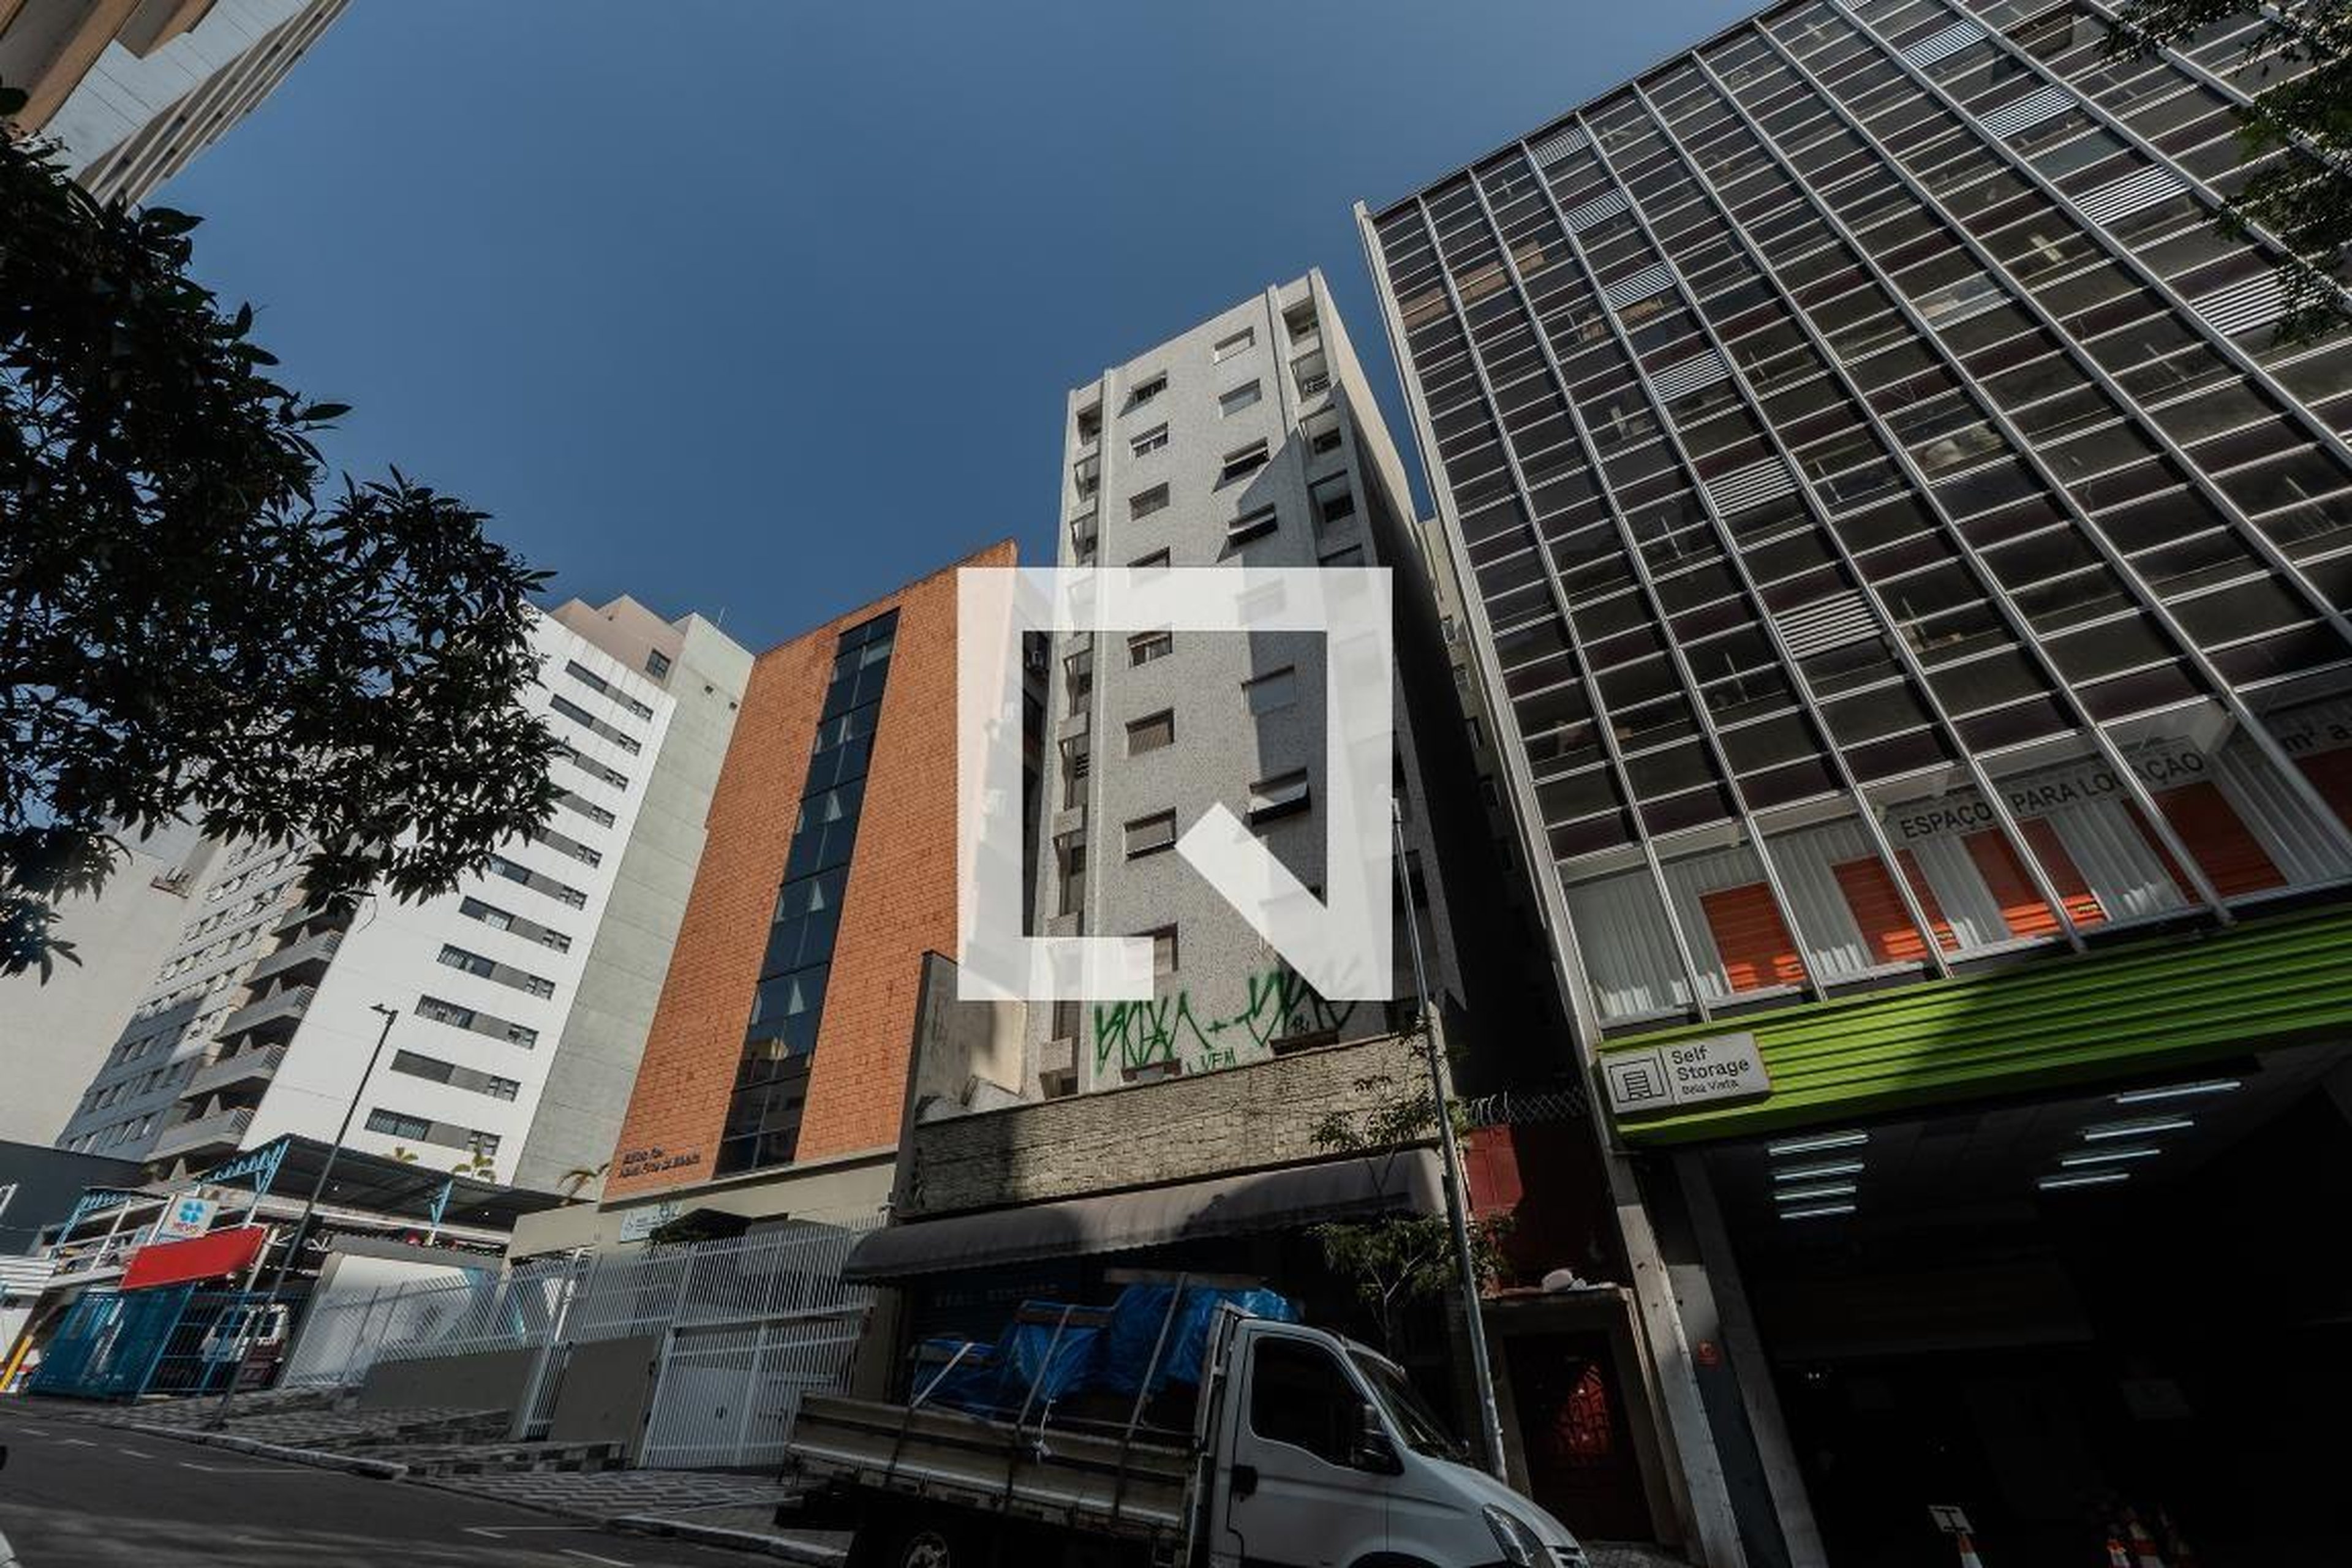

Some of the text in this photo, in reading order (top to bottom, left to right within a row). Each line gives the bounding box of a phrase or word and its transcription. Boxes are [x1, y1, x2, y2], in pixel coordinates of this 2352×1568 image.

[1900, 802, 1992, 839] ESPAÇO
[2010, 783, 2080, 813] PARA
[1672, 1044, 1708, 1065] Self
[1676, 1058, 1749, 1081] Storage
